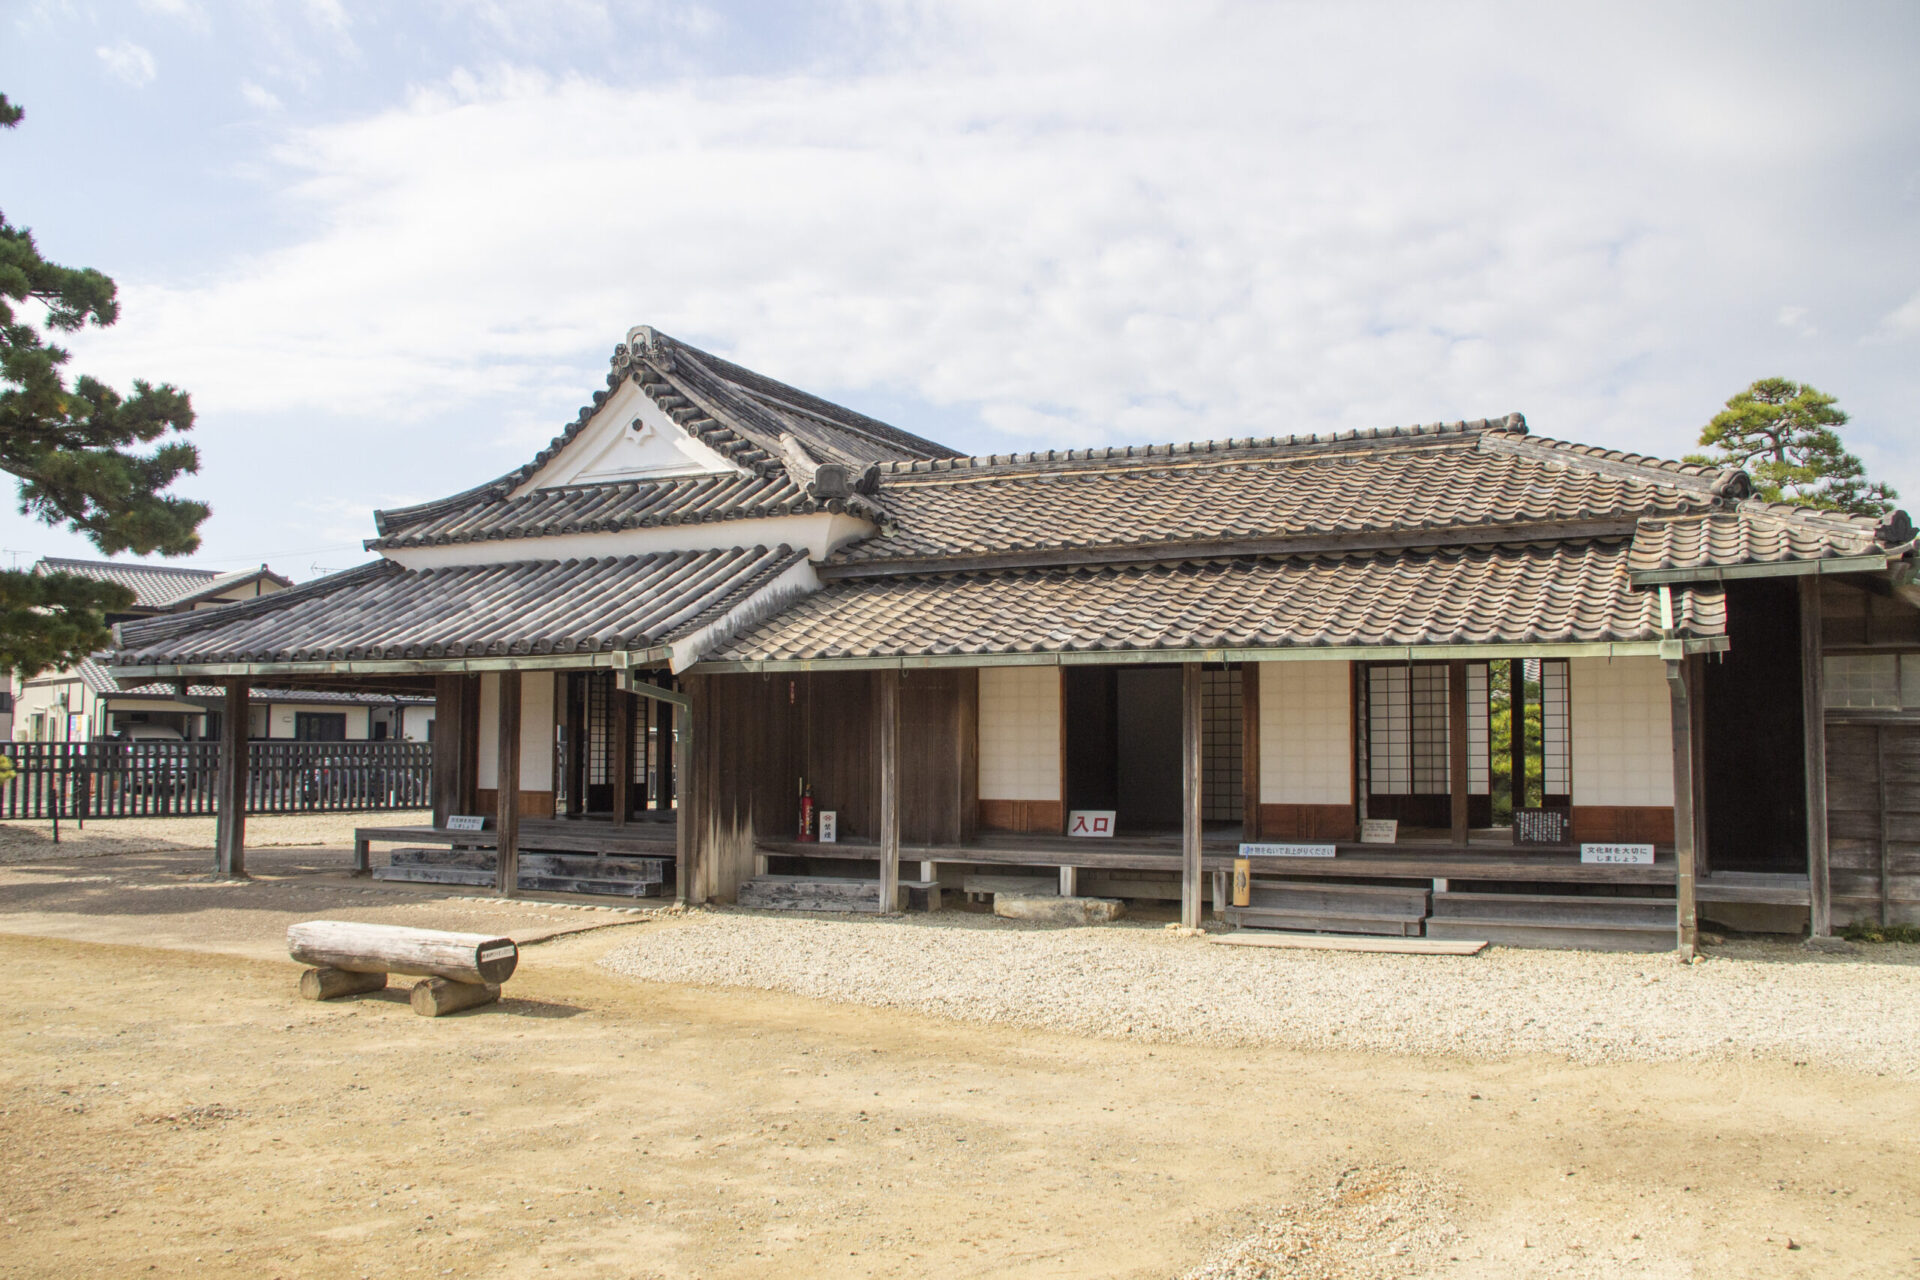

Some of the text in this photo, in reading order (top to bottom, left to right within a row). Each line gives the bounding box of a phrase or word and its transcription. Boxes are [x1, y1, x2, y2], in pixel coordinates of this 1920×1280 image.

[1072, 816, 1109, 832] 入口
[1587, 847, 1648, 855] 文化財を大切に
